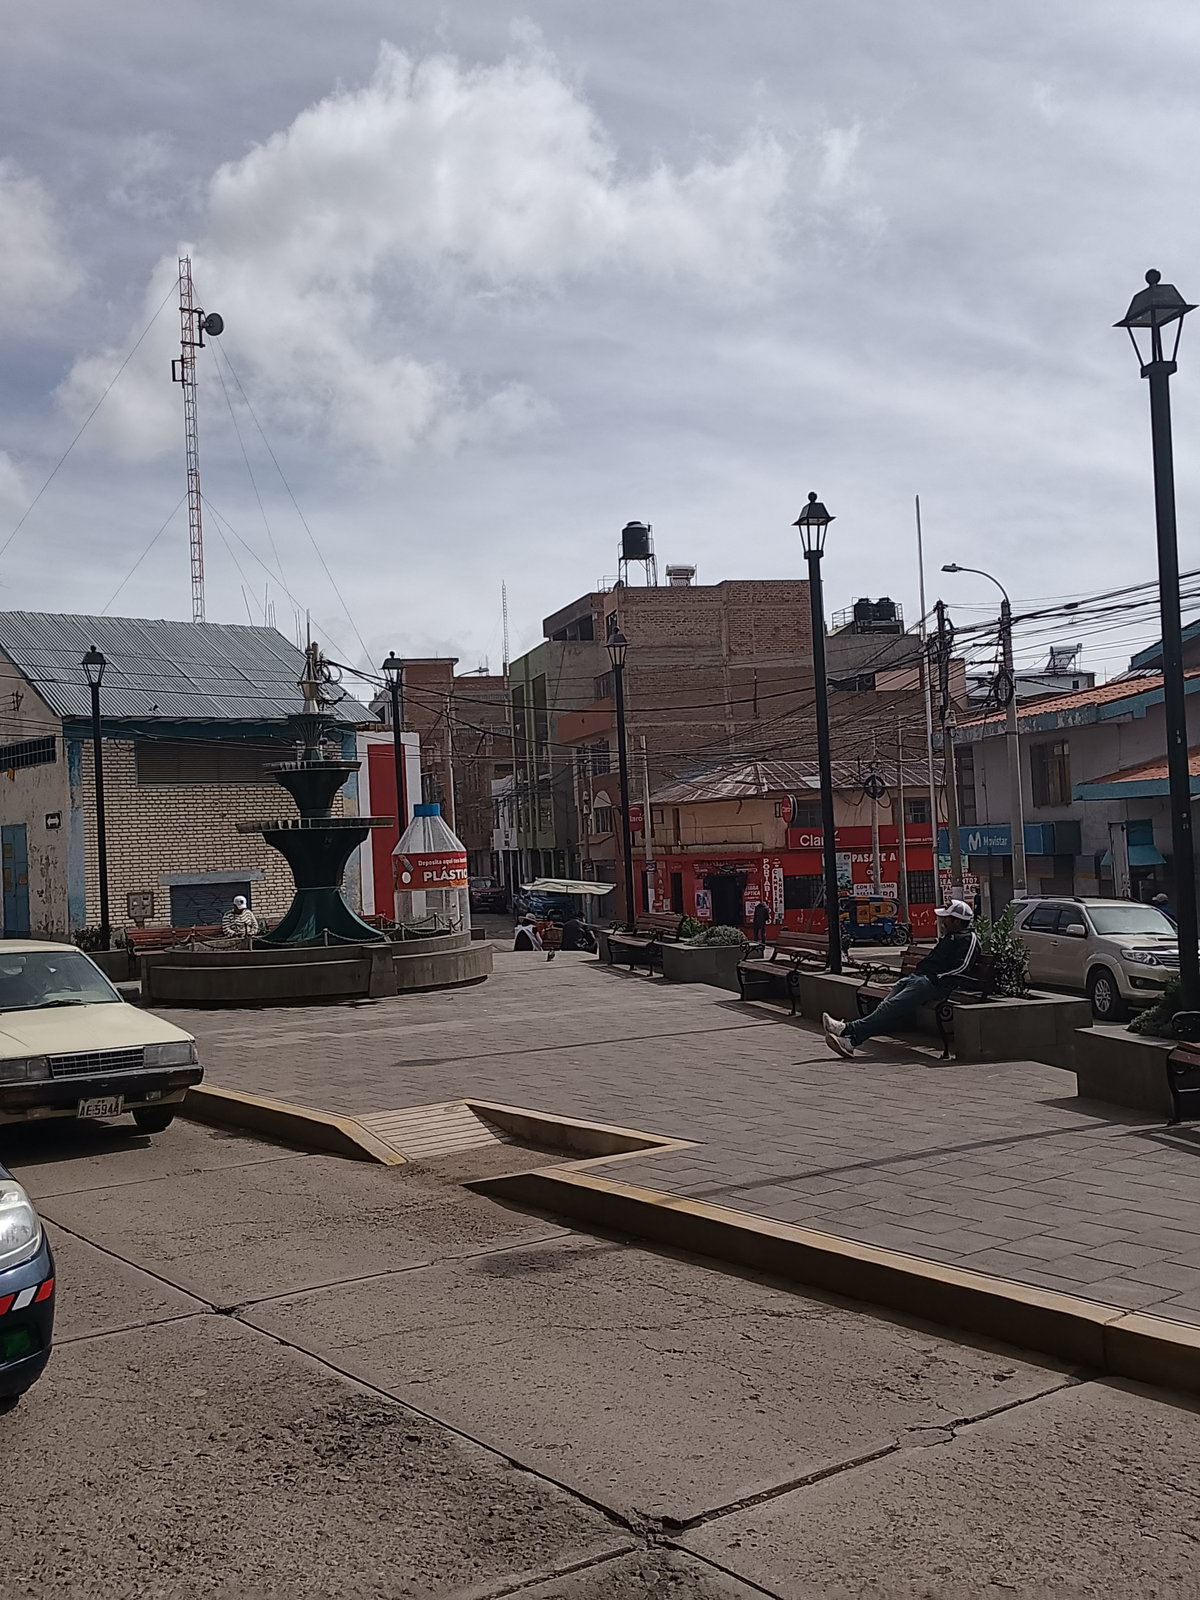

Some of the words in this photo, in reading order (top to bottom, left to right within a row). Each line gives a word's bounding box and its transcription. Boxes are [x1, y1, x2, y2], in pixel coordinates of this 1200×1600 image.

[629, 814, 643, 822] laro
[983, 836, 1007, 846] Movistar
[852, 852, 887, 862] PASAE
[890, 852, 897, 861] A
